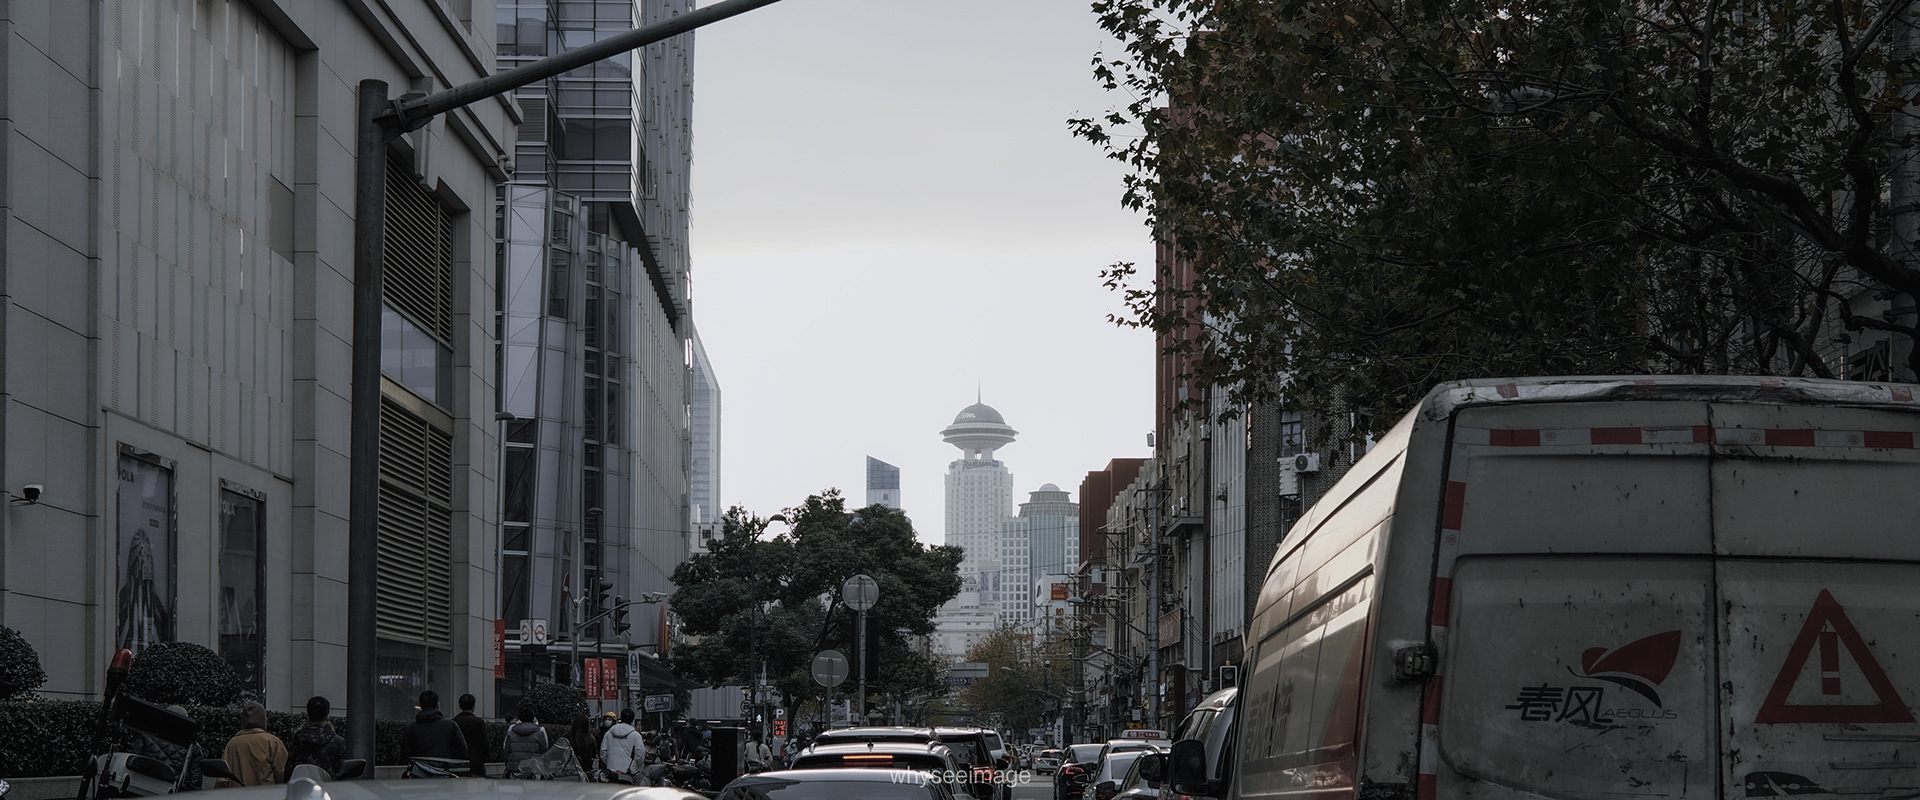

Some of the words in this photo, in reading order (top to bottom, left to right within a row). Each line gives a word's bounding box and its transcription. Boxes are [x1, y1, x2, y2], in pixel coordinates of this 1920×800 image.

[119, 467, 135, 484] OLA
[222, 499, 236, 517] OLA
[1505, 682, 1613, 723] 春风
[1600, 708, 1678, 720] AEOLUS
